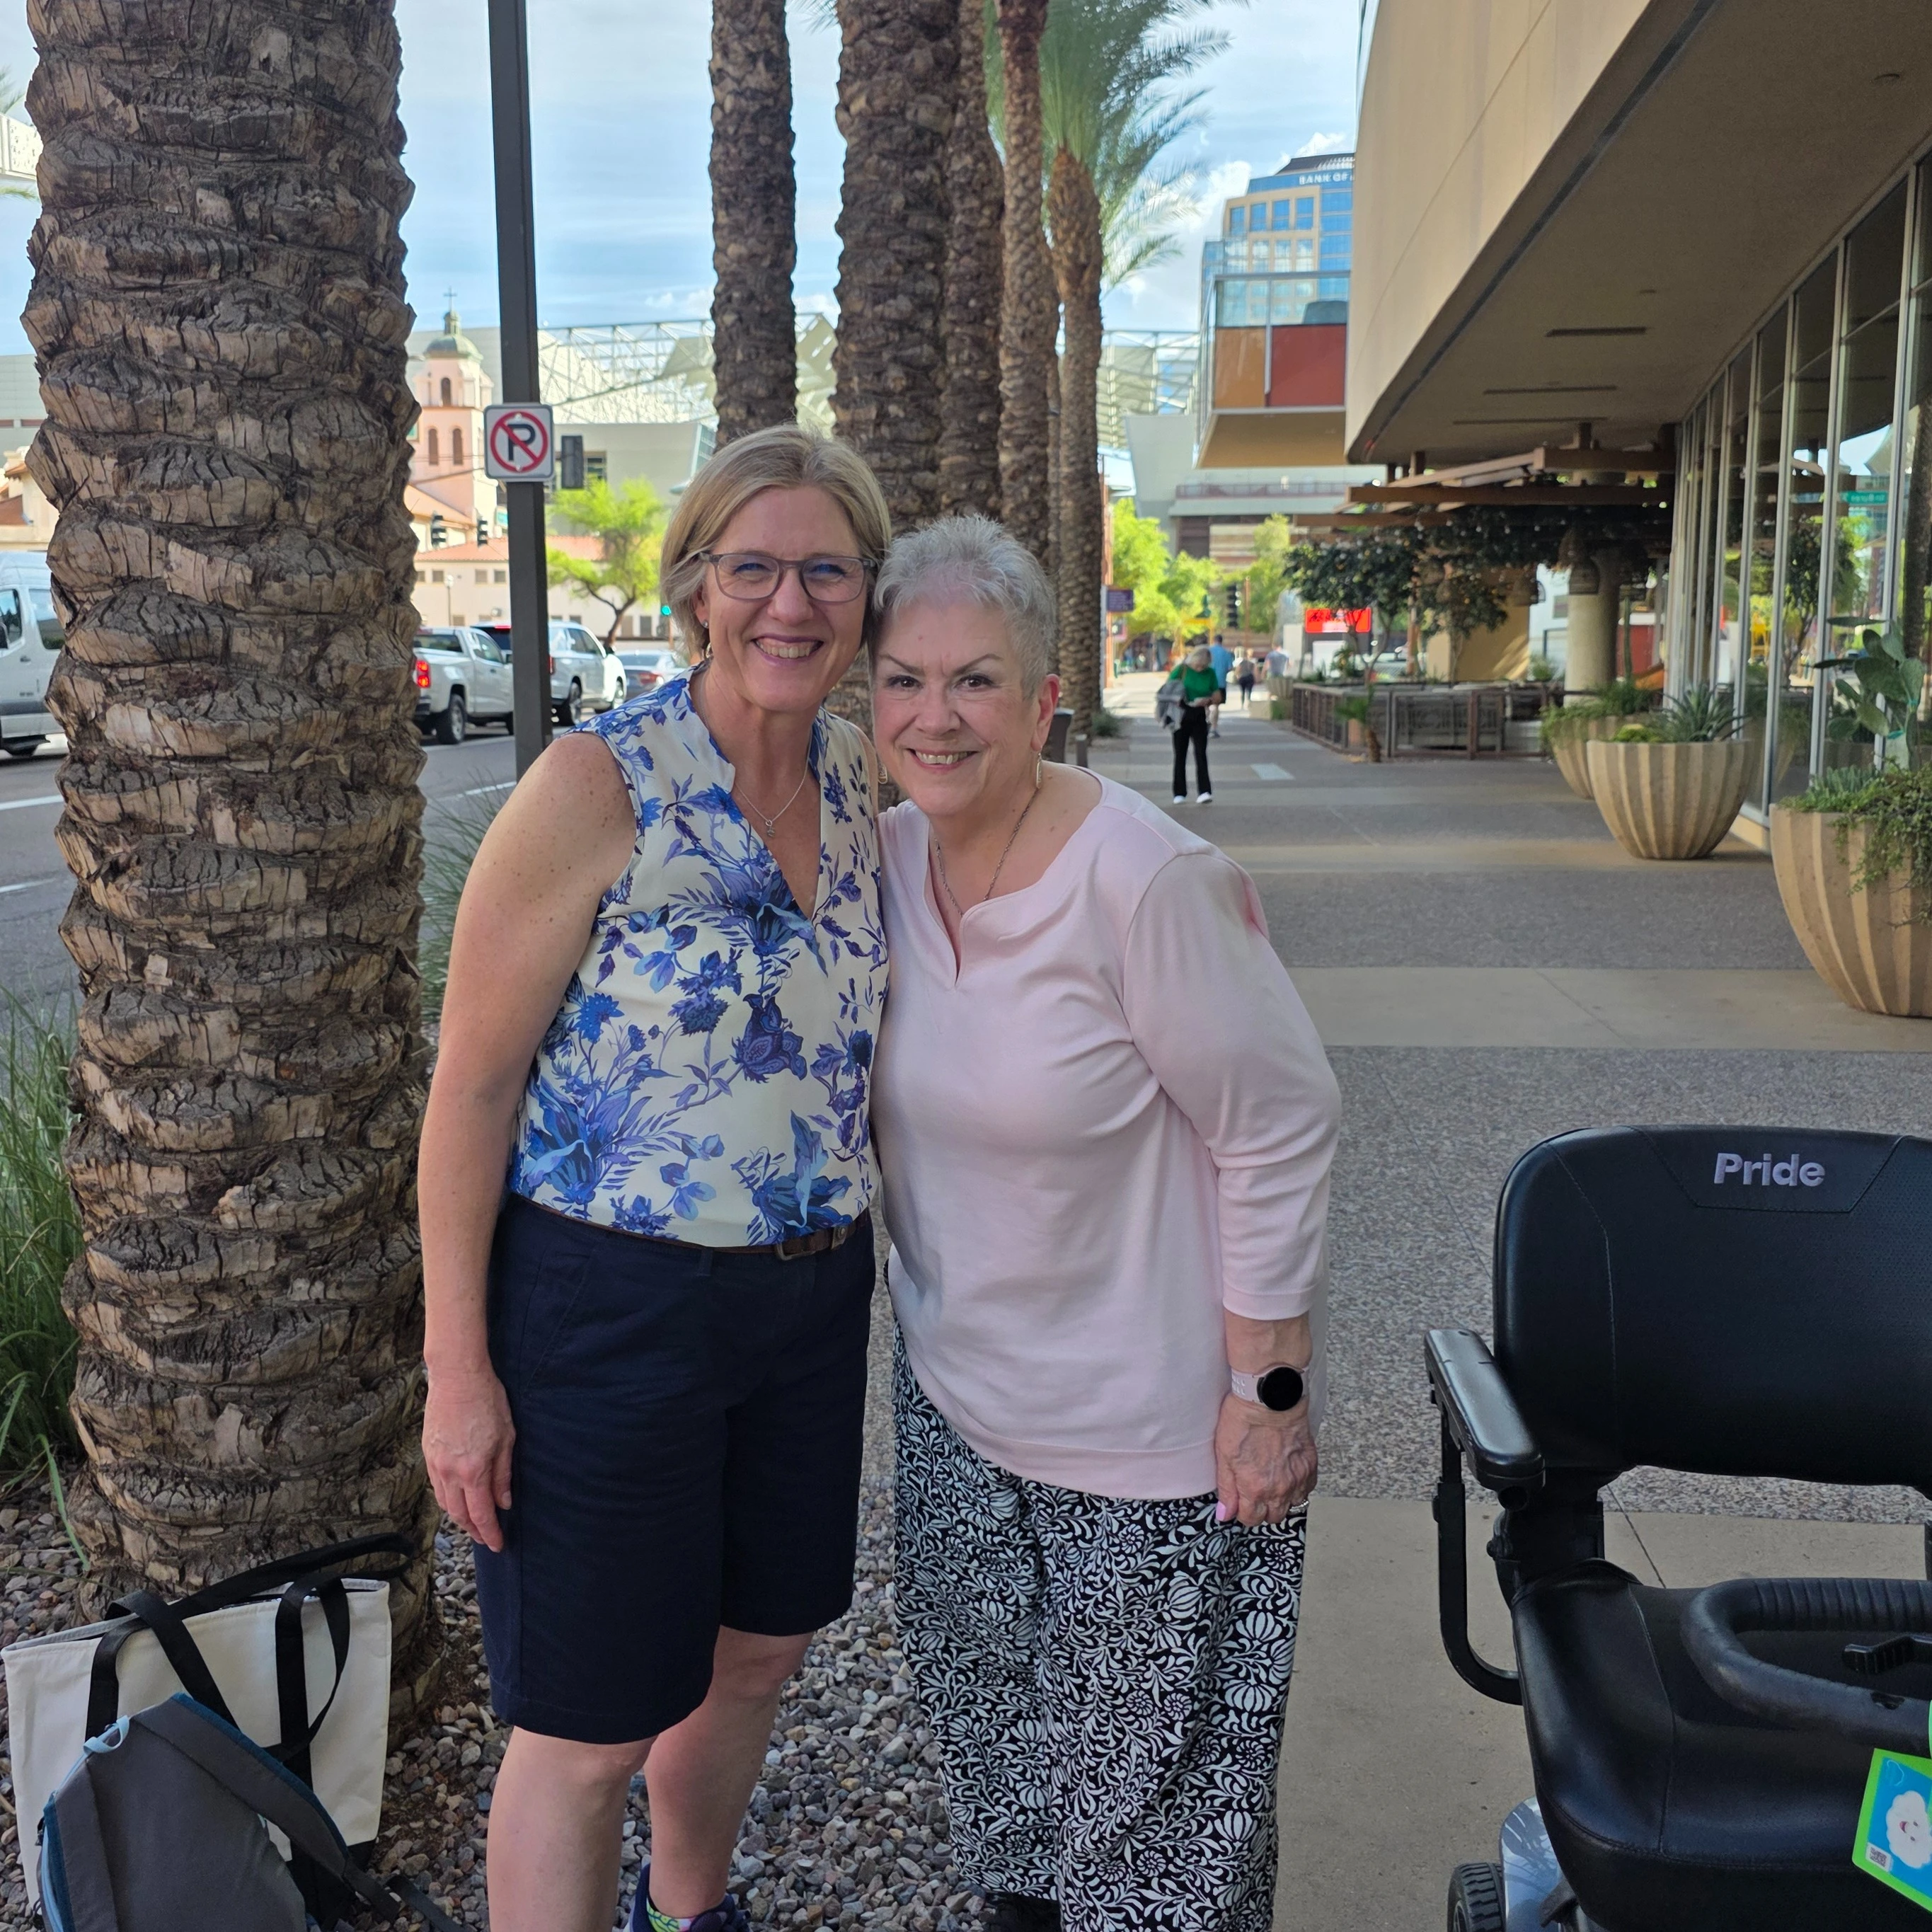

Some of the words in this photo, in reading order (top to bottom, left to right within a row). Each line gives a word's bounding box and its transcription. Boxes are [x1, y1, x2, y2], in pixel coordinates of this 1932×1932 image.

[1299, 173, 1330, 185] BANK
[1333, 172, 1349, 182] OF
[507, 424, 536, 461] P
[1713, 1152, 1826, 1187] Pride
